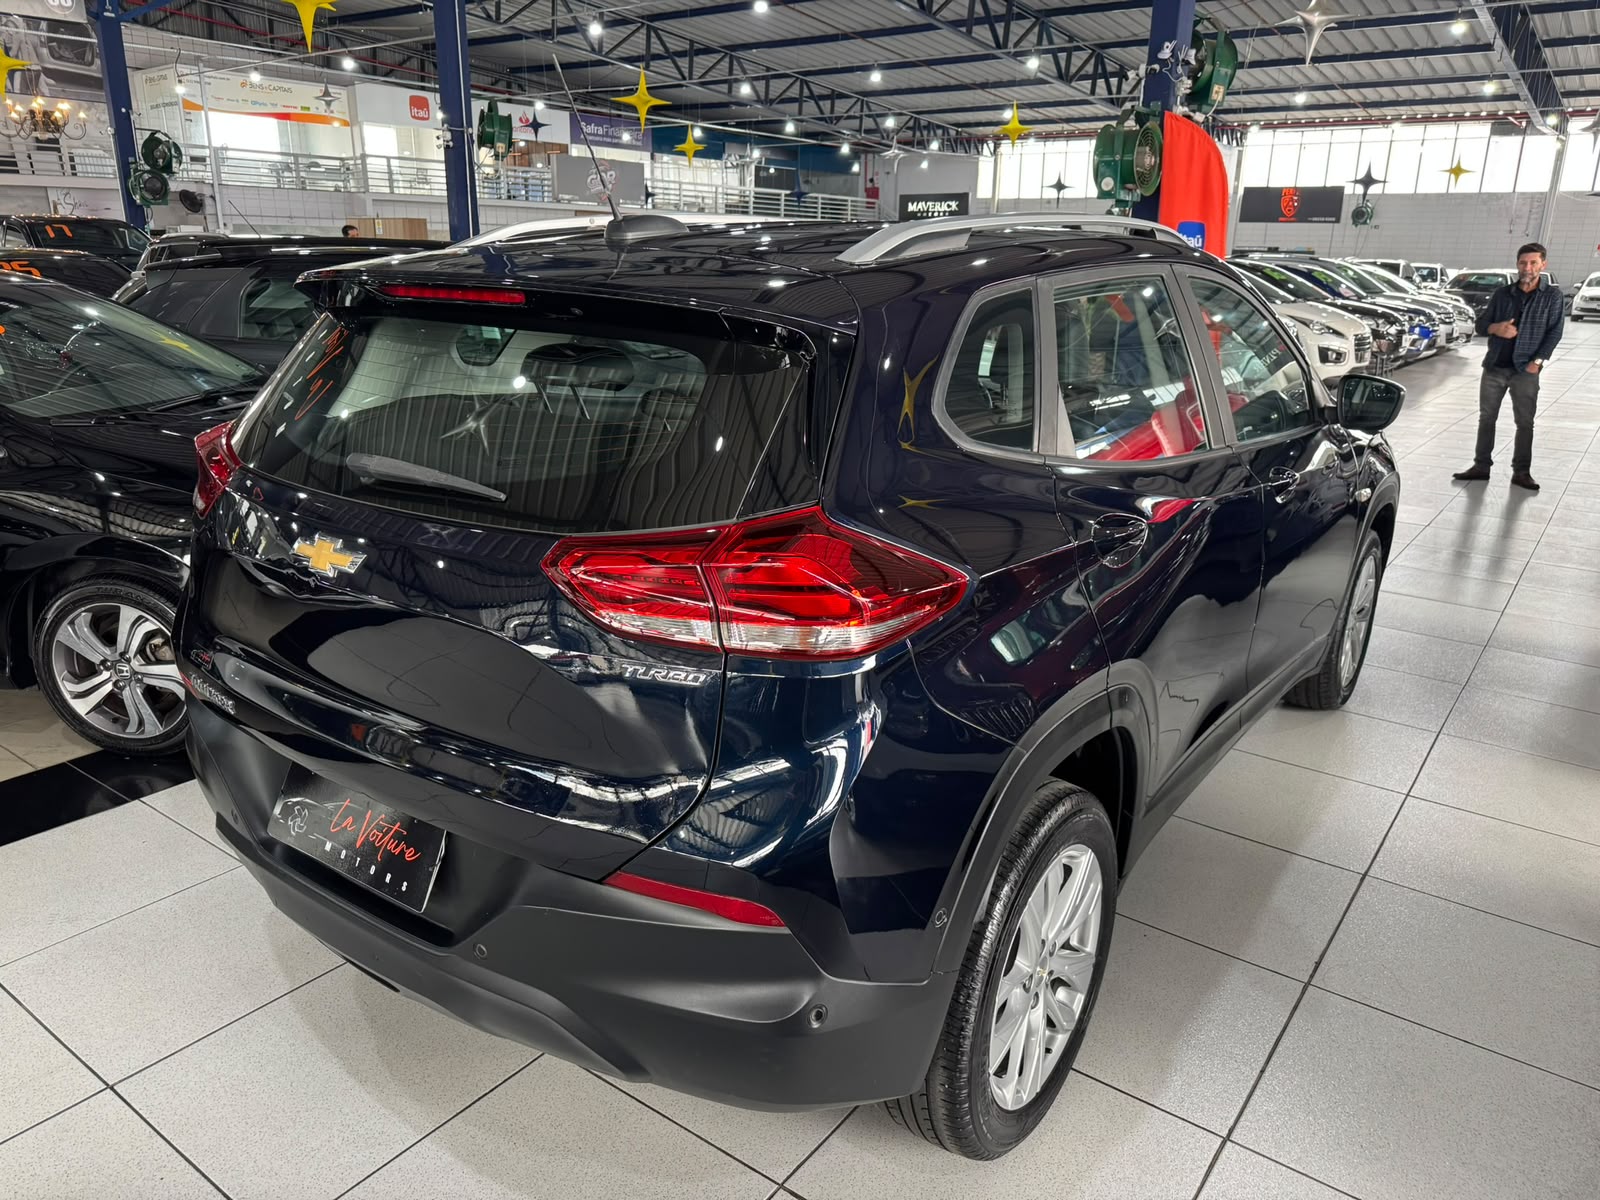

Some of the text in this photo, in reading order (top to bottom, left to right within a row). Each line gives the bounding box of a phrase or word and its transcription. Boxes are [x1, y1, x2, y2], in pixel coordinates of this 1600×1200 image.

[907, 200, 959, 212] MAVERICK
[622, 664, 705, 685] TURBO
[329, 799, 422, 862] La Voiture
[323, 840, 408, 891] MOTORS
